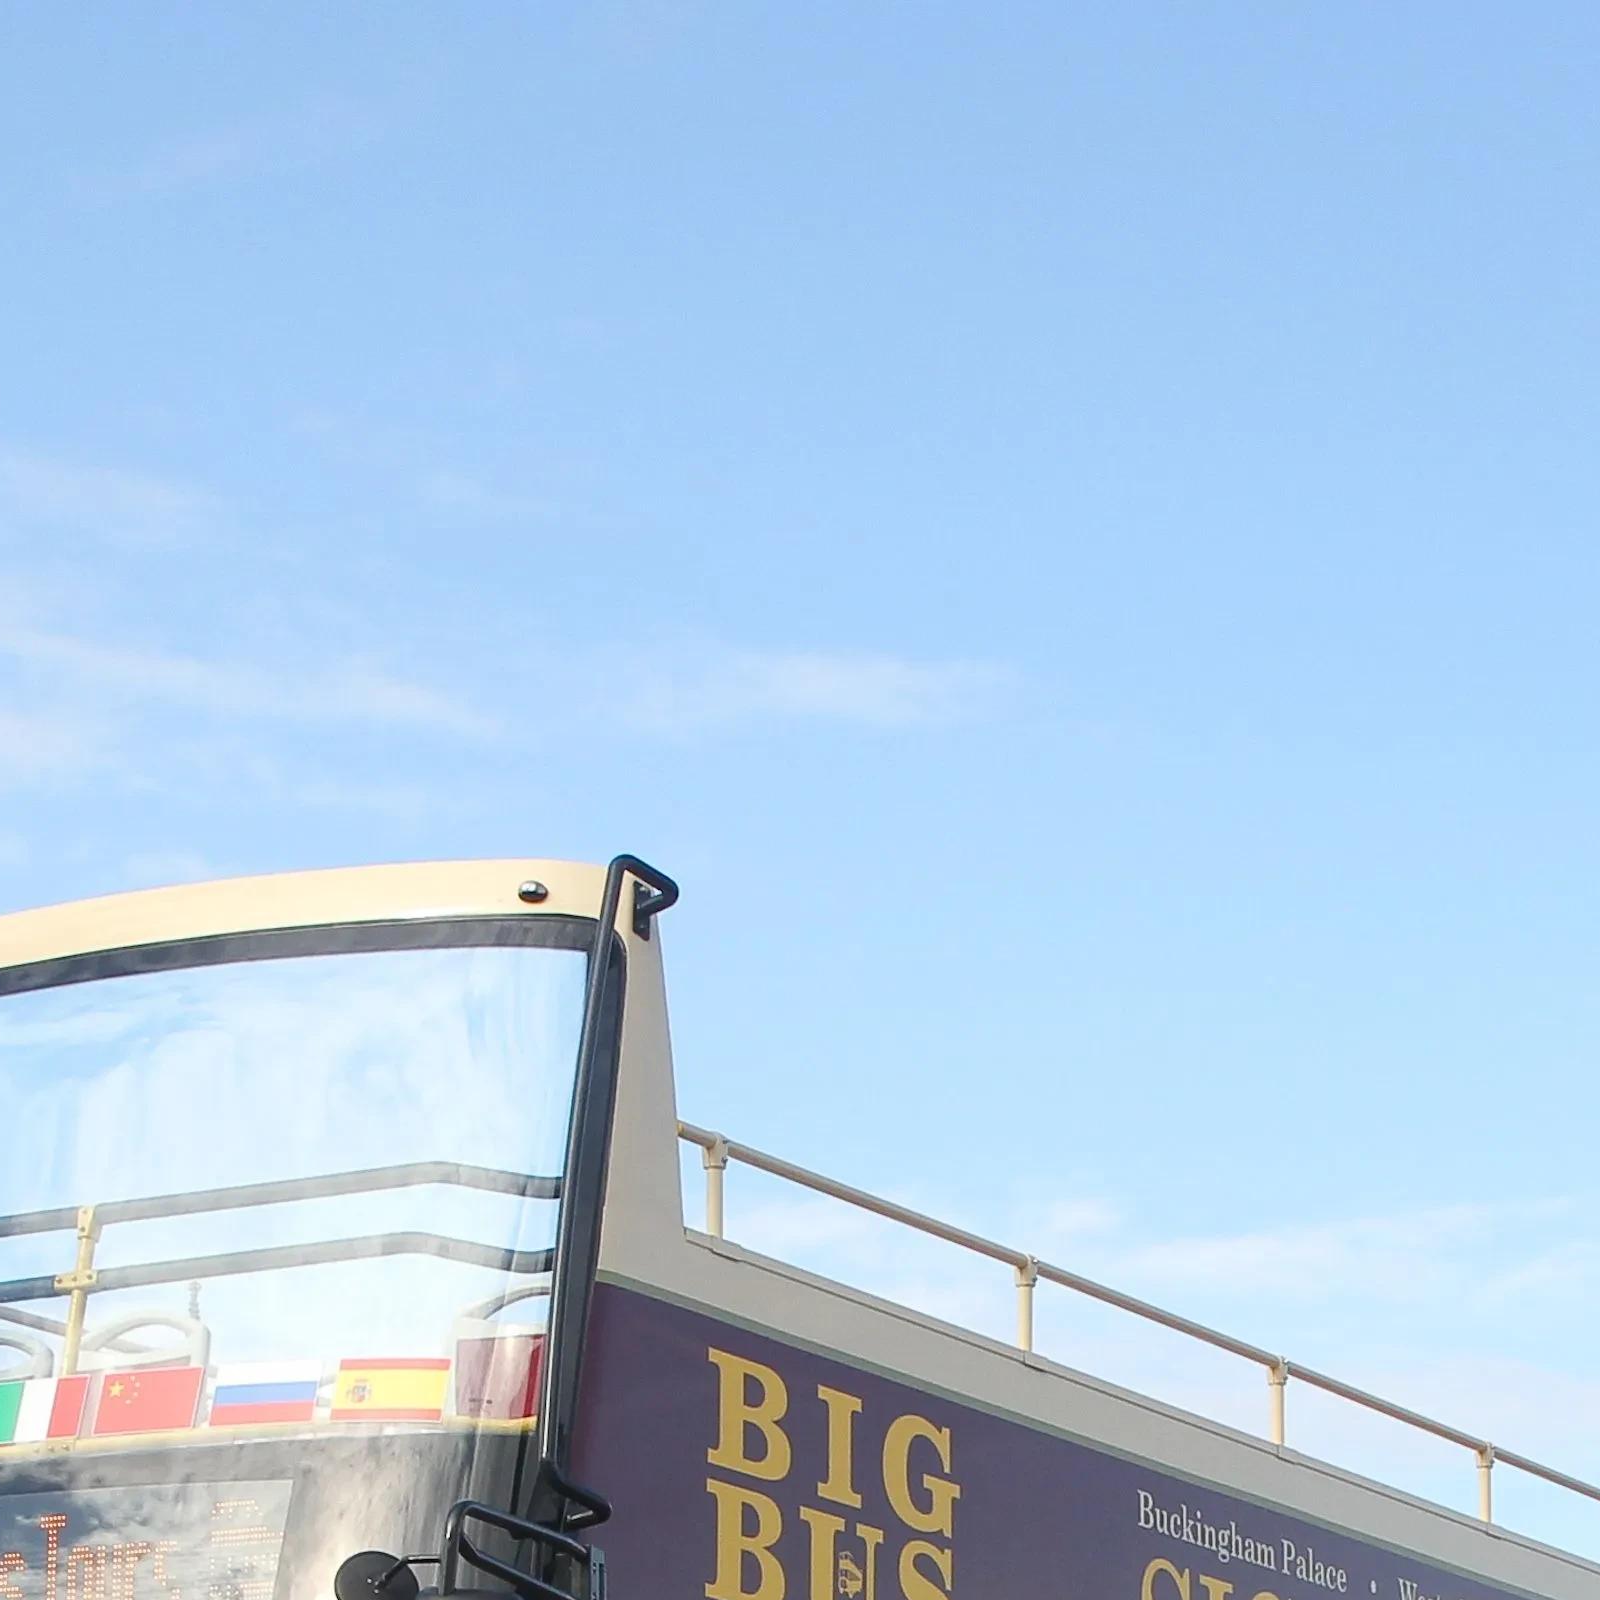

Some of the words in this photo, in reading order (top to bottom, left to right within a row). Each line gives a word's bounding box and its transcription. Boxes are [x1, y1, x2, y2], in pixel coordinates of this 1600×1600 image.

[706, 1347, 961, 1537] BIG
[1138, 1490, 1275, 1569] Buckingham
[1282, 1538, 1348, 1593] Palace
